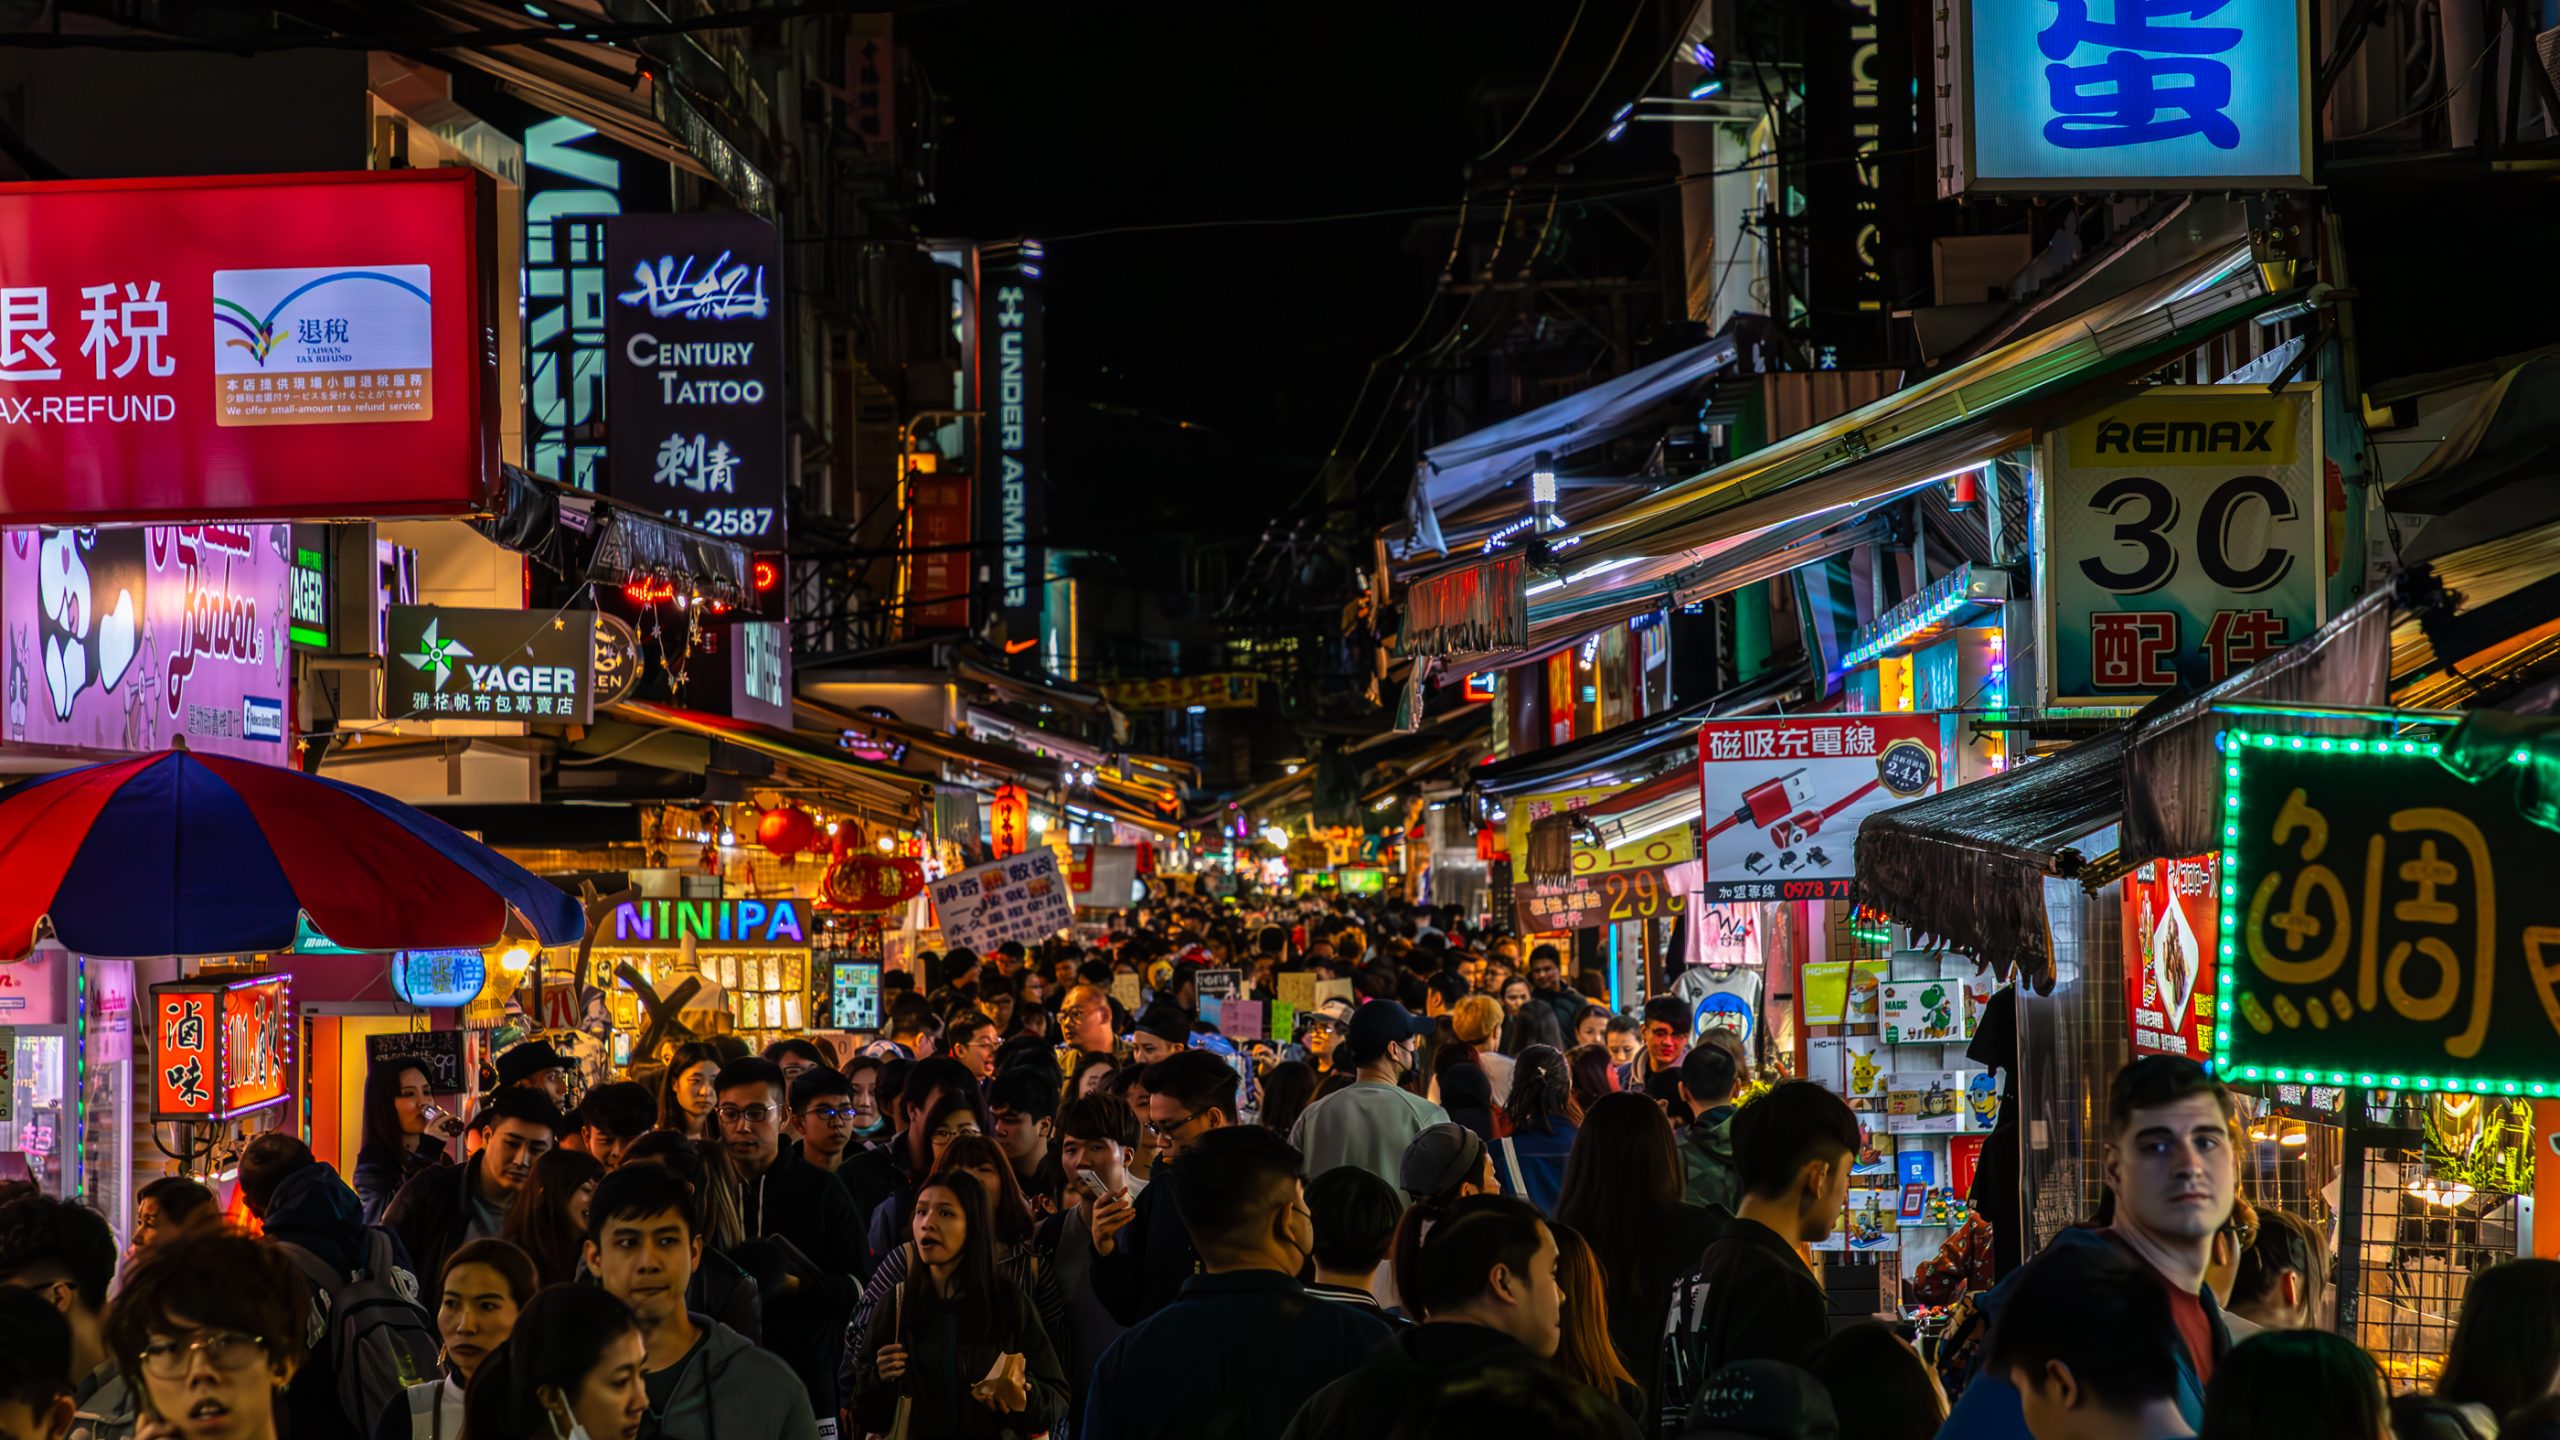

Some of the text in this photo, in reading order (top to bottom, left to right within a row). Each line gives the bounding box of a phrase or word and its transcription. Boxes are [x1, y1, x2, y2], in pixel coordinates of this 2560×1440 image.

[296, 354, 352, 364] TAX REFUND
[306, 347, 341, 355] TAIWAN
[626, 332, 754, 367] CENTURY
[658, 370, 765, 404] TATTOO
[1000, 330, 1026, 450] UNDER
[226, 401, 423, 416] We offer small-amount tax refund service.
[2096, 416, 2275, 454] REMAX
[654, 432, 741, 494] 刺青
[663, 507, 774, 536] 1-2587
[1000, 455, 1027, 608] ARMOUR
[2079, 475, 2299, 595] 3C
[2090, 608, 2290, 692] 配件
[465, 664, 576, 694] YAGER
[412, 692, 574, 716] 雅格帆布包專賣店
[1709, 725, 1877, 760] 磁吸充電線
[1885, 760, 1924, 785] 2.4A
[1572, 841, 1673, 872] OLO
[1783, 881, 1825, 898] 0978
[616, 899, 804, 943] NINIPA
[166, 1000, 210, 1107] 滷味
